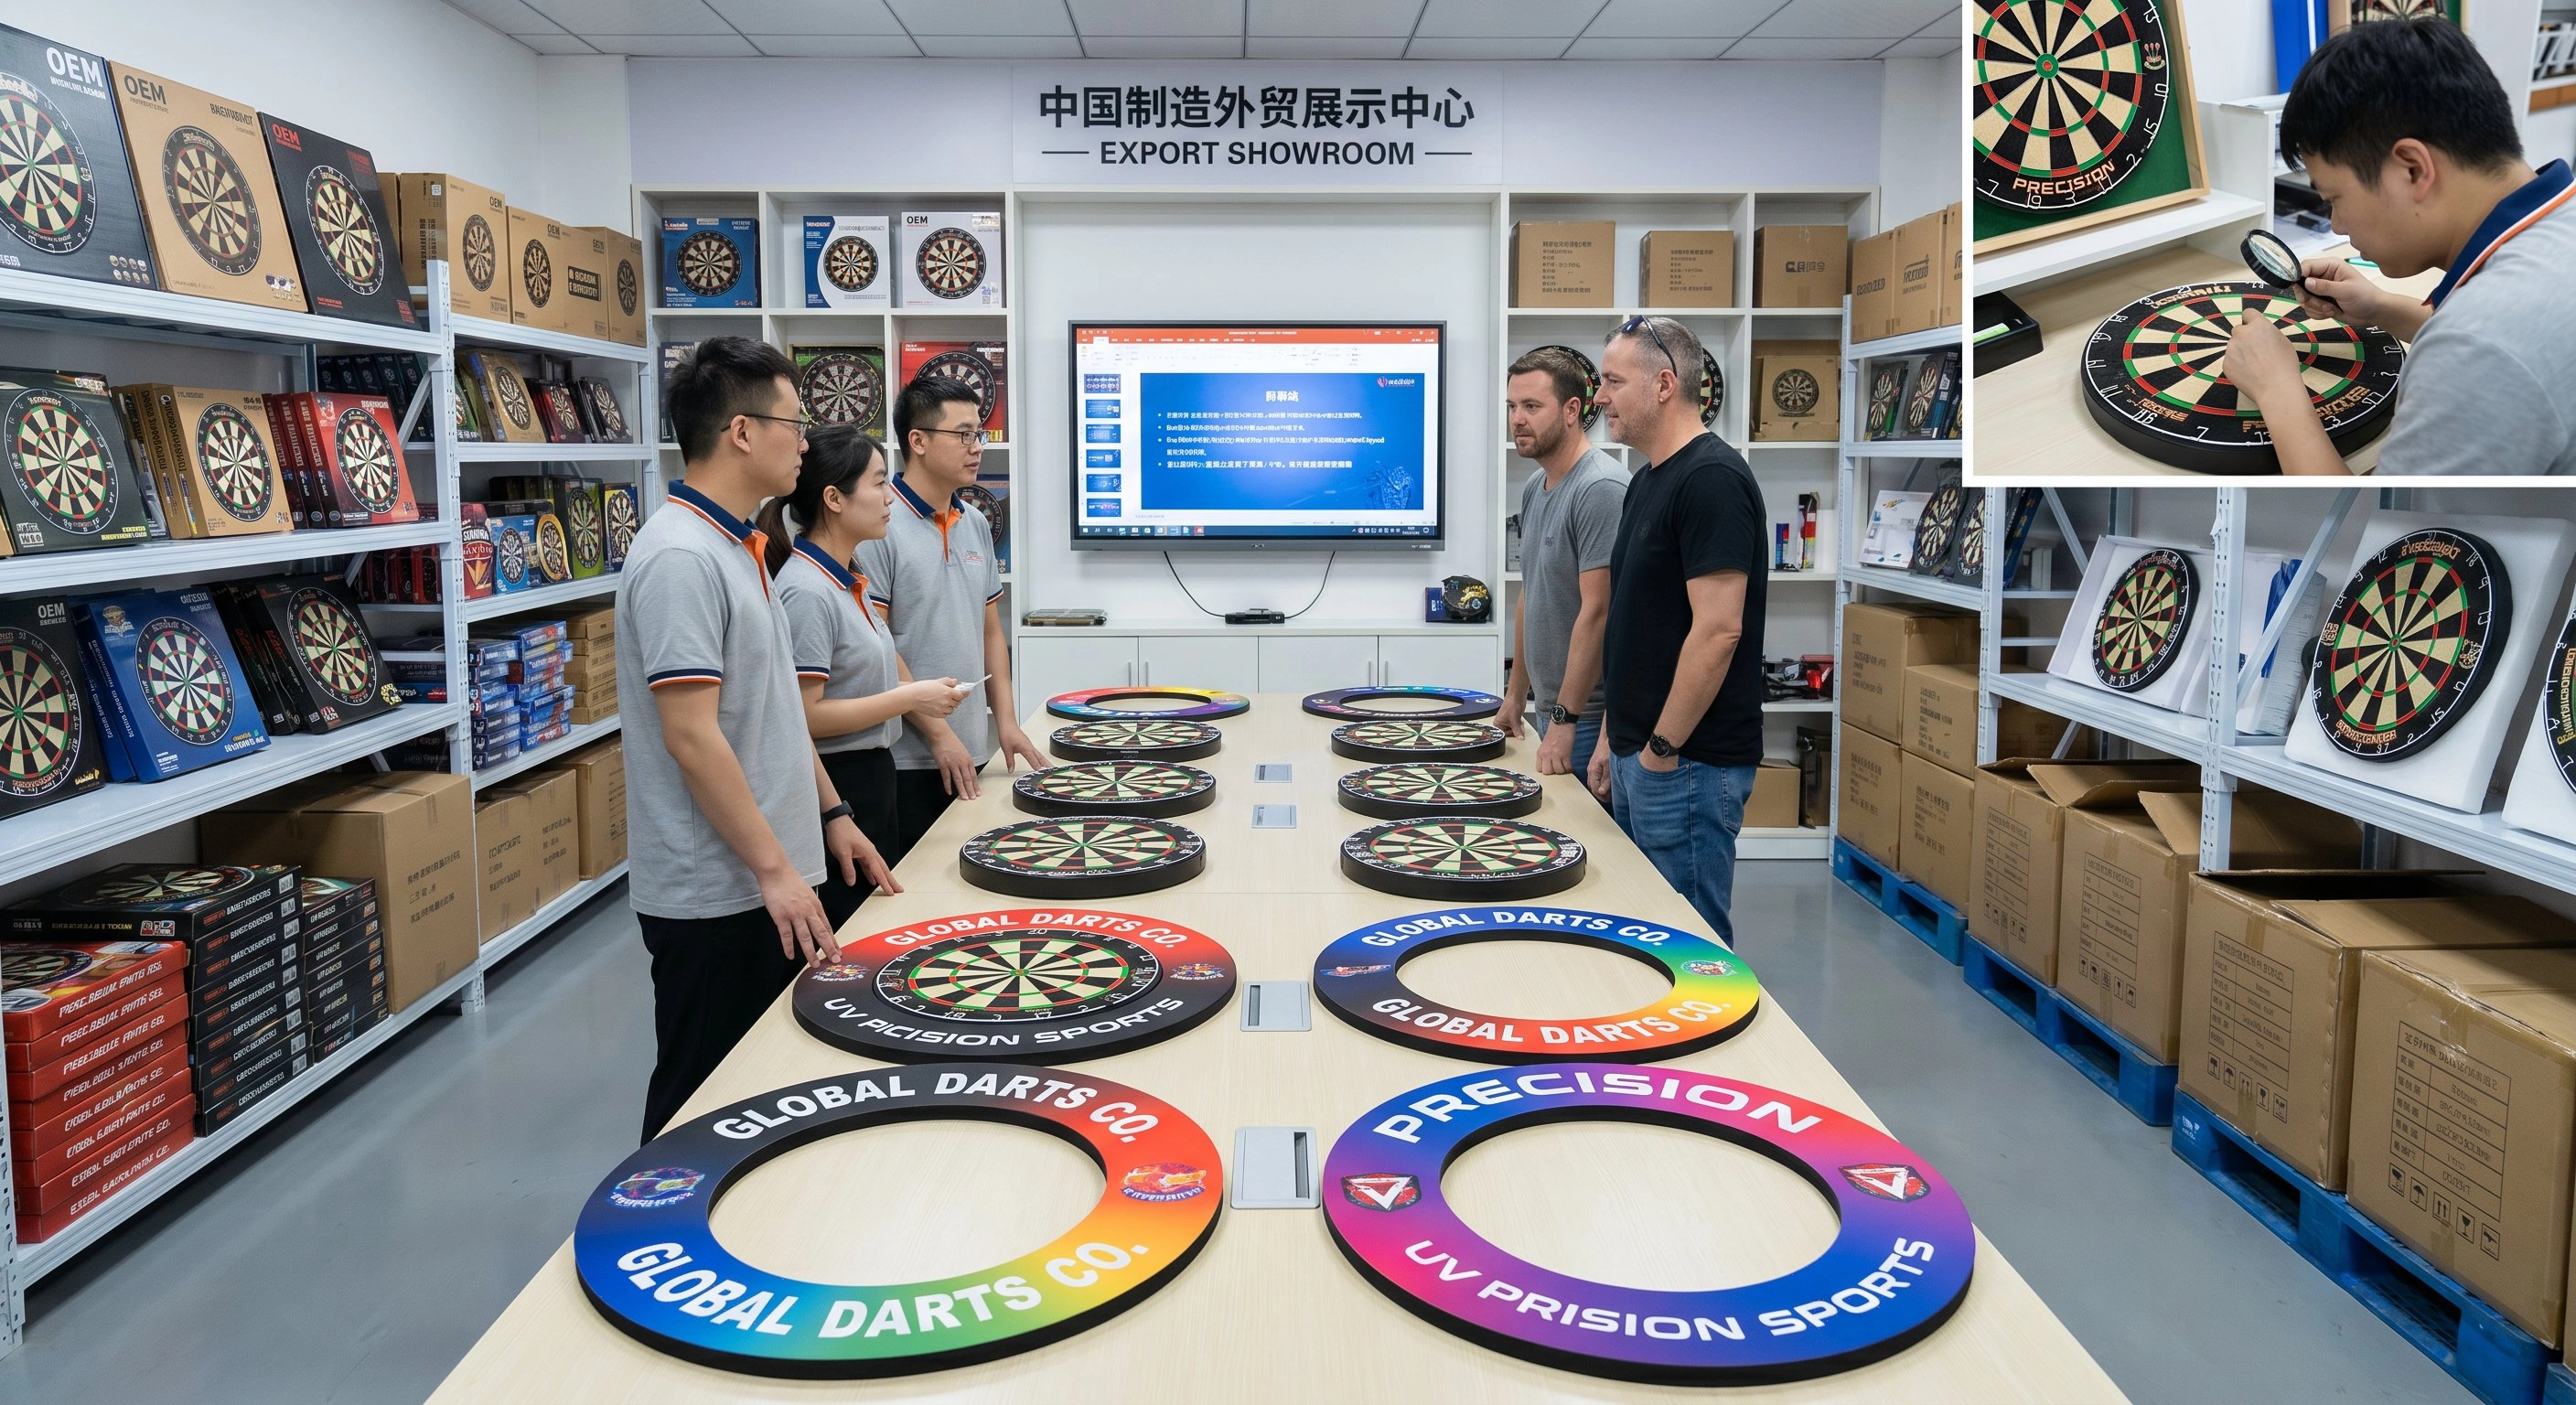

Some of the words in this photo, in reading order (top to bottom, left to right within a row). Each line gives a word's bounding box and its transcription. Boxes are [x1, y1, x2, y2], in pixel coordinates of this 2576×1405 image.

[46, 47, 103, 88] OEM
[123, 75, 167, 105] OEM
[1039, 84, 1476, 129] 中国制造外贸展示中心
[272, 123, 300, 145] OEM
[1100, 141, 1219, 165] EXPORT
[1227, 141, 1415, 166] SHOWROOM
[2012, 157, 2117, 195] PRECISION
[907, 216, 928, 224] OEM
[38, 603, 66, 618] OEM
[884, 914, 1021, 946] GLOBAL
[1029, 912, 1143, 933] DARTS
[1139, 927, 1188, 949] CO.
[1361, 913, 1485, 948] GLOBAL
[1493, 911, 1615, 931] DARTS
[1617, 926, 1671, 947] CO.
[824, 997, 869, 1019] UV
[857, 1014, 1021, 1046] PICISION
[1035, 997, 1185, 1045] SPORTS
[1372, 997, 1525, 1044] GLOBAL
[1540, 1015, 1680, 1045] DARTS
[1667, 999, 1731, 1024] CO.
[713, 1075, 917, 1141] GLOBAL
[933, 1072, 1099, 1110] DARTS
[1089, 1101, 1160, 1143] CO.
[1372, 1071, 1823, 1144] PRECISION
[617, 1242, 799, 1335] GLOBAL
[818, 1275, 1044, 1339] DARTS
[1045, 1242, 1150, 1289] CO.
[1405, 1240, 1483, 1282] UV
[1476, 1280, 1747, 1342] PRISION
[1758, 1237, 1936, 1337] SPORTS
